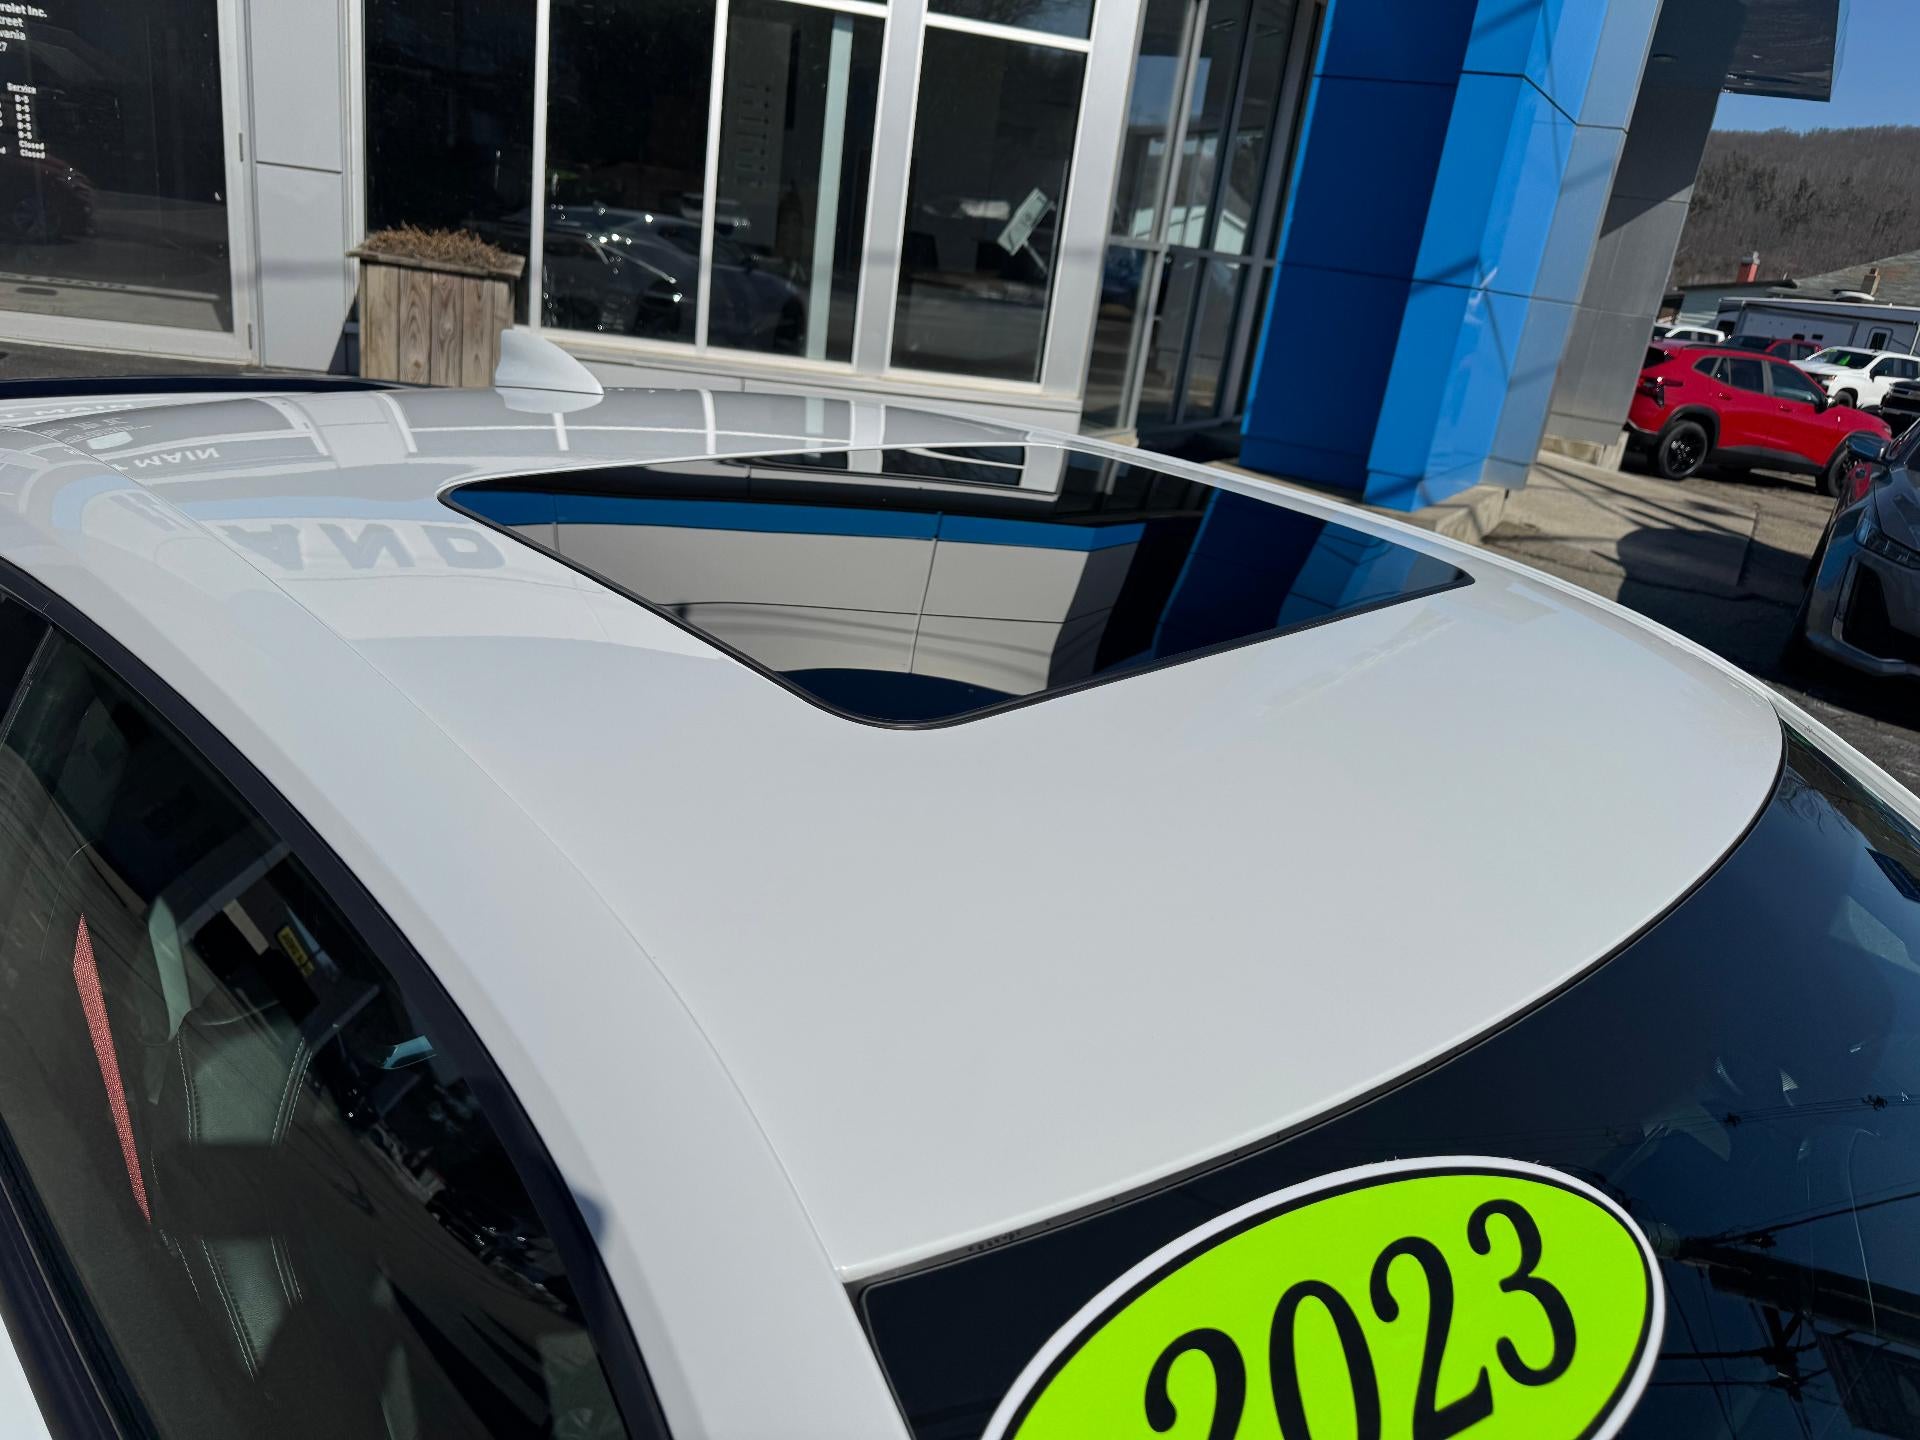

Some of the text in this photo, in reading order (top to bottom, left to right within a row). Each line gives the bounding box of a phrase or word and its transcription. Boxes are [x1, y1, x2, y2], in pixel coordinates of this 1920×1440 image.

[6, 82, 37, 94] Service
[18, 140, 45, 150] Closed
[20, 149, 46, 159] Closed
[1145, 1198, 1577, 1440] 2023
